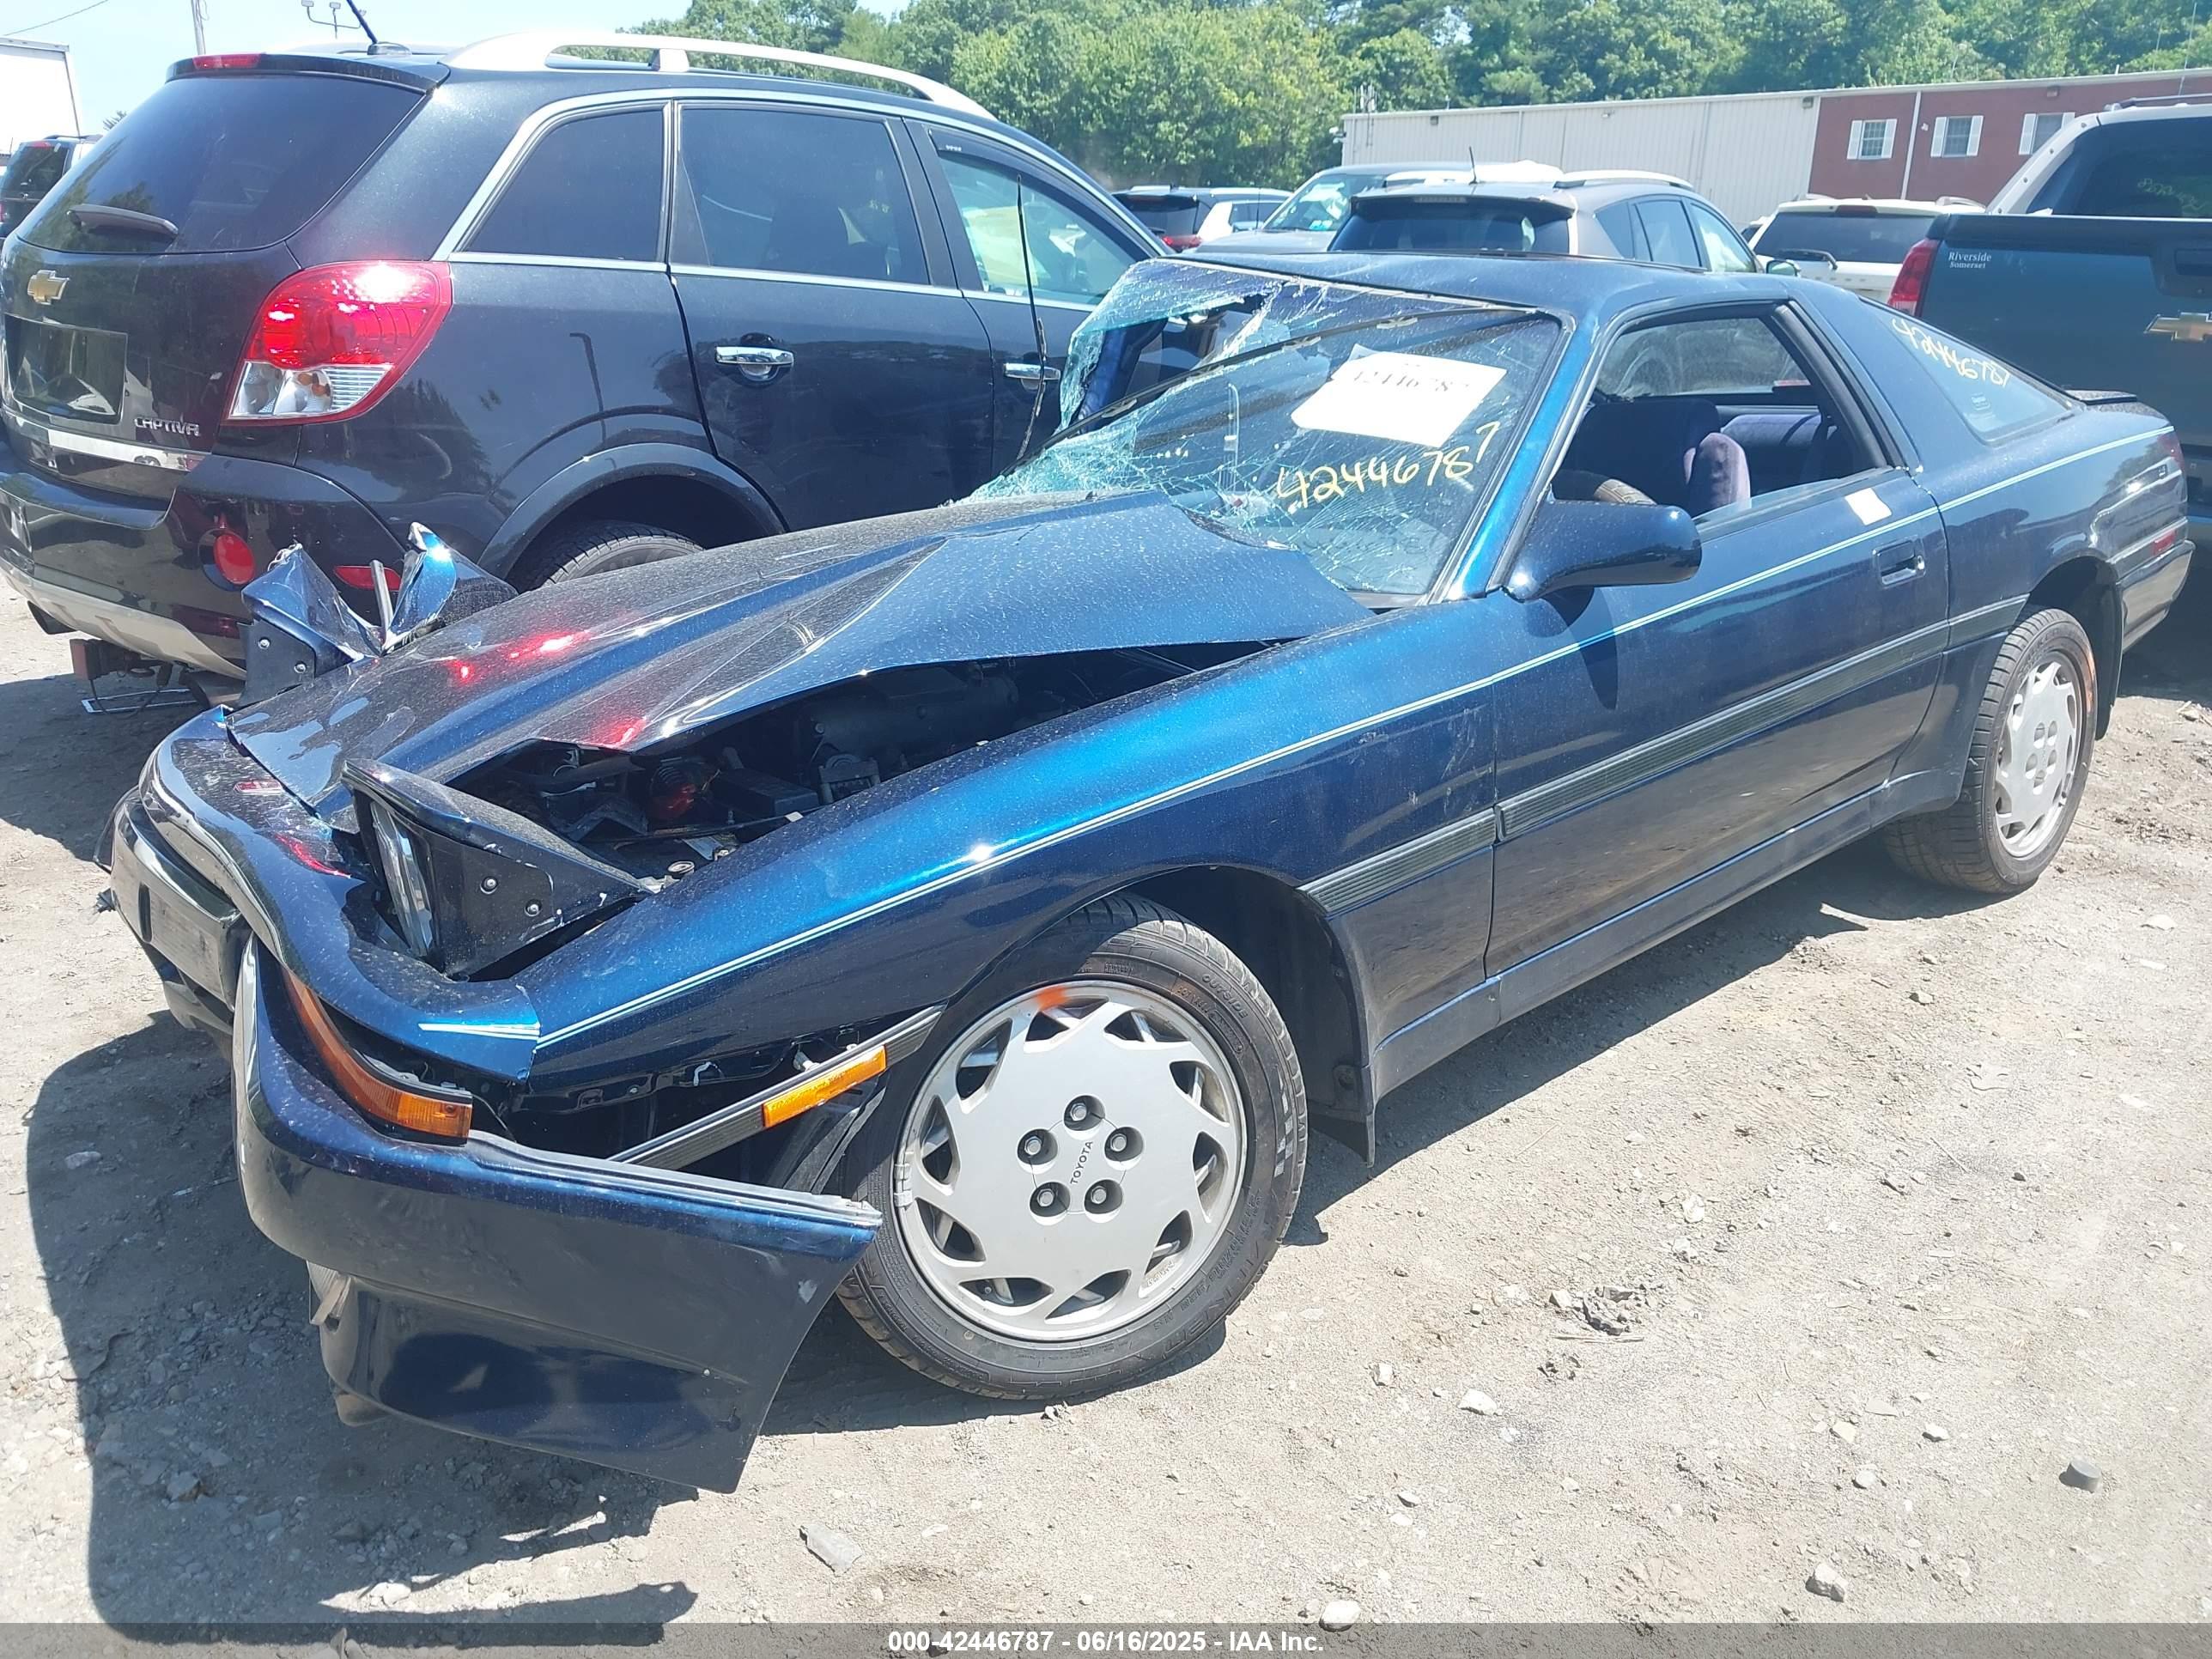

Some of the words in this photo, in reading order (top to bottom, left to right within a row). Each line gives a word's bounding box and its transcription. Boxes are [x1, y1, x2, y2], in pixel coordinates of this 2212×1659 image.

[1948, 251, 1992, 261] Riverside
[134, 416, 200, 436] CAPTIVA
[1277, 421, 1500, 508] 42446787
[1202, 974, 1248, 1018] OUTSIDE
[1070, 1141, 1093, 1184] TOYOTA
